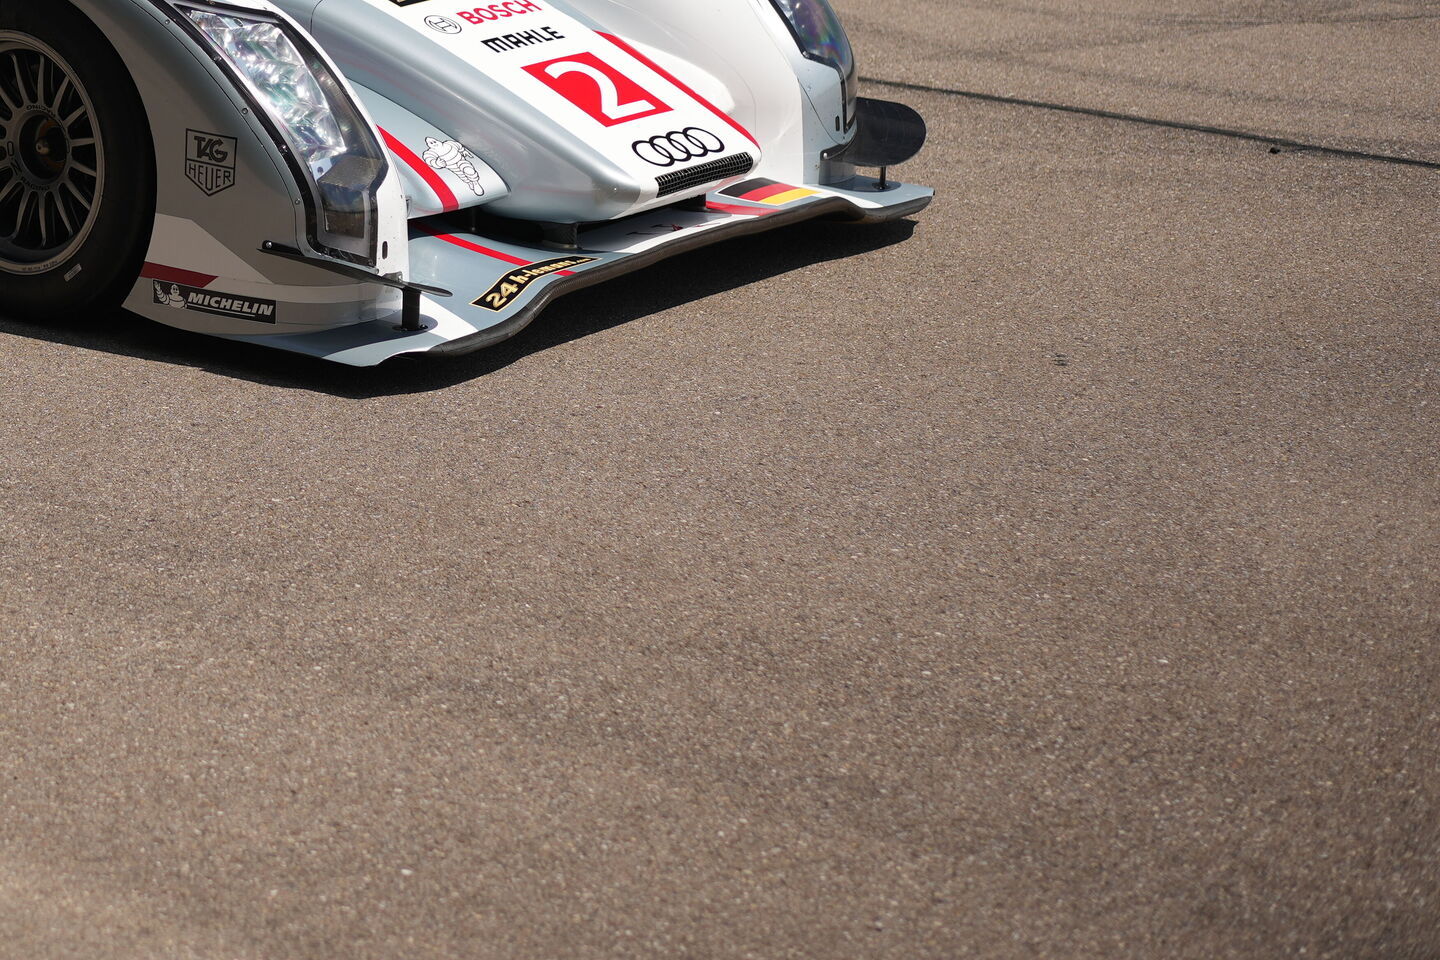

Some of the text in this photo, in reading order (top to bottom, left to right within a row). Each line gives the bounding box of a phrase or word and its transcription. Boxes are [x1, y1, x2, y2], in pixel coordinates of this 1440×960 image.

[481, 26, 565, 53] MAHLE
[544, 60, 657, 121] 2
[194, 135, 228, 162] TAG
[188, 162, 232, 191] HEUER
[187, 292, 274, 316] MICHELIN
